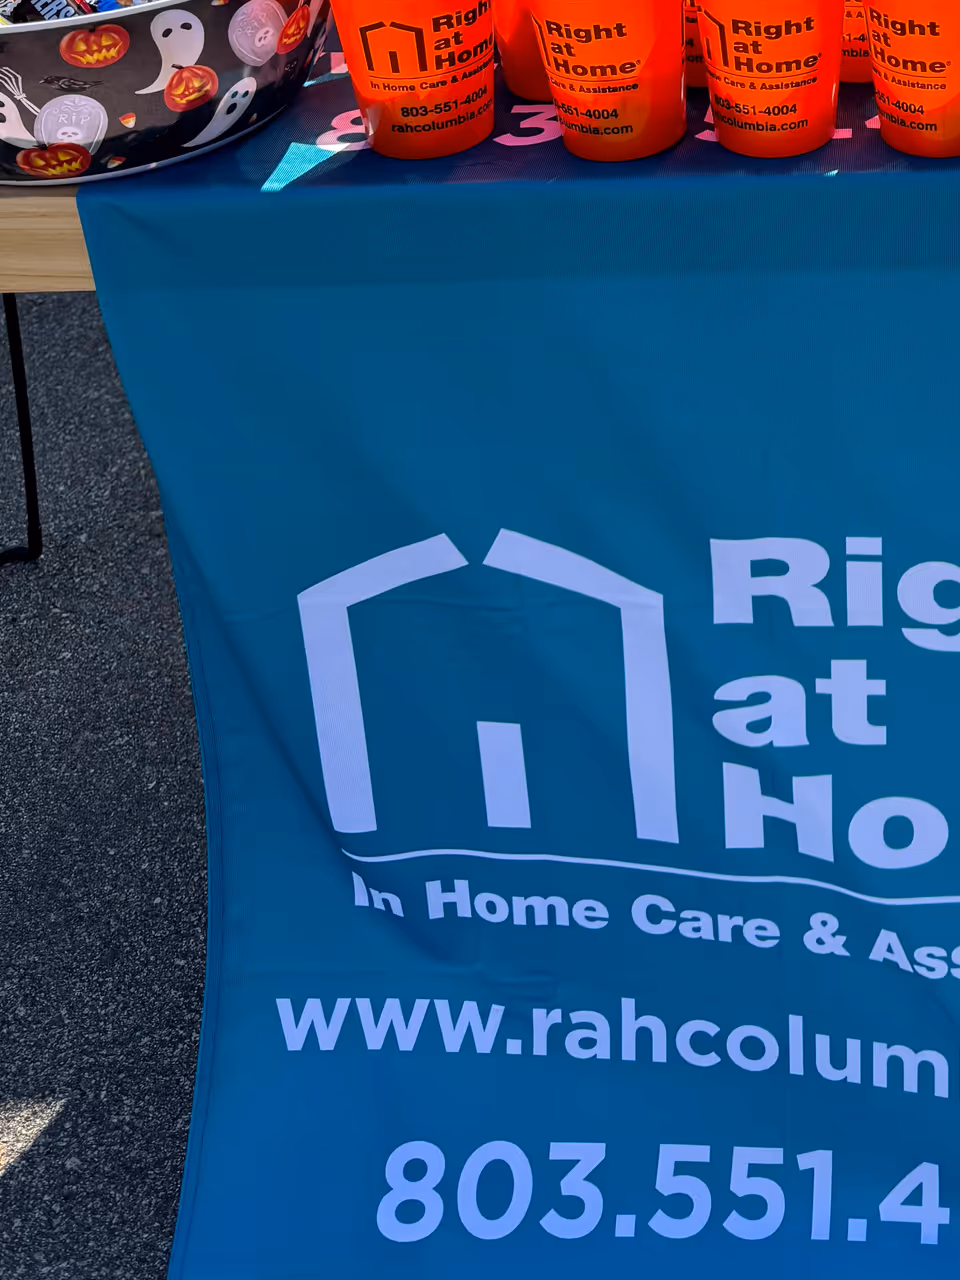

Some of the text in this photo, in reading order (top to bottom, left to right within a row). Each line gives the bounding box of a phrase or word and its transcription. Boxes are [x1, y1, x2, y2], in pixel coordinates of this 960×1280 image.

[545, 20, 627, 43] Right
[732, 17, 815, 40] Right
[869, 7, 940, 37] Right
[434, 31, 463, 51] at
[734, 41, 763, 54] at
[872, 30, 891, 48] at
[551, 42, 576, 57] at
[383, 83, 415, 92] Home
[420, 80, 447, 90] Care
[451, 75, 458, 83] &
[569, 84, 576, 92] &
[579, 83, 639, 94] Assistance
[724, 76, 745, 88] Care
[749, 82, 756, 90] &
[760, 77, 817, 90] Assistance
[891, 77, 947, 90] Assistance
[401, 86, 486, 117] 803-551-4004
[712, 659, 887, 748] at
[351, 871, 404, 917] In
[425, 879, 609, 929] Home
[631, 894, 781, 948] Care
[803, 912, 850, 956] &
